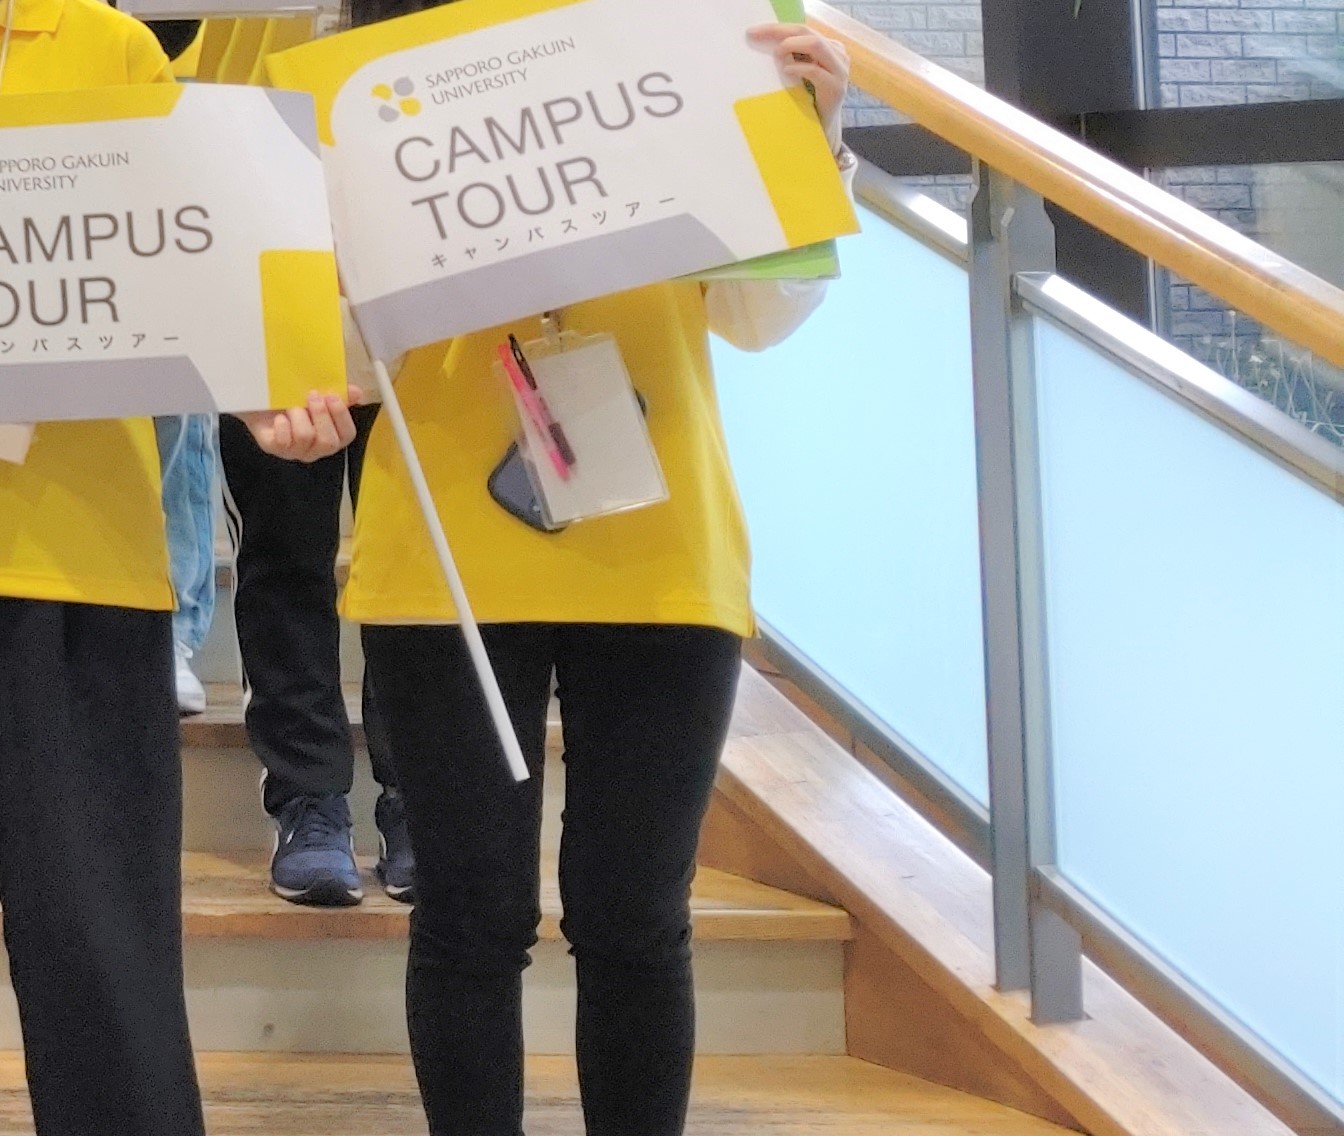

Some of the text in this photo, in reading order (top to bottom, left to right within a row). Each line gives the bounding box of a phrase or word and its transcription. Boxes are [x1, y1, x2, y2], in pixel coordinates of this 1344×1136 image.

[425, 36, 576, 88] SAPPORO GAKUIN
[431, 68, 529, 106] UNIVERSITY
[393, 70, 685, 183] CAMPUS
[61, 151, 130, 170] GAKUIN
[411, 155, 609, 242] TOUR
